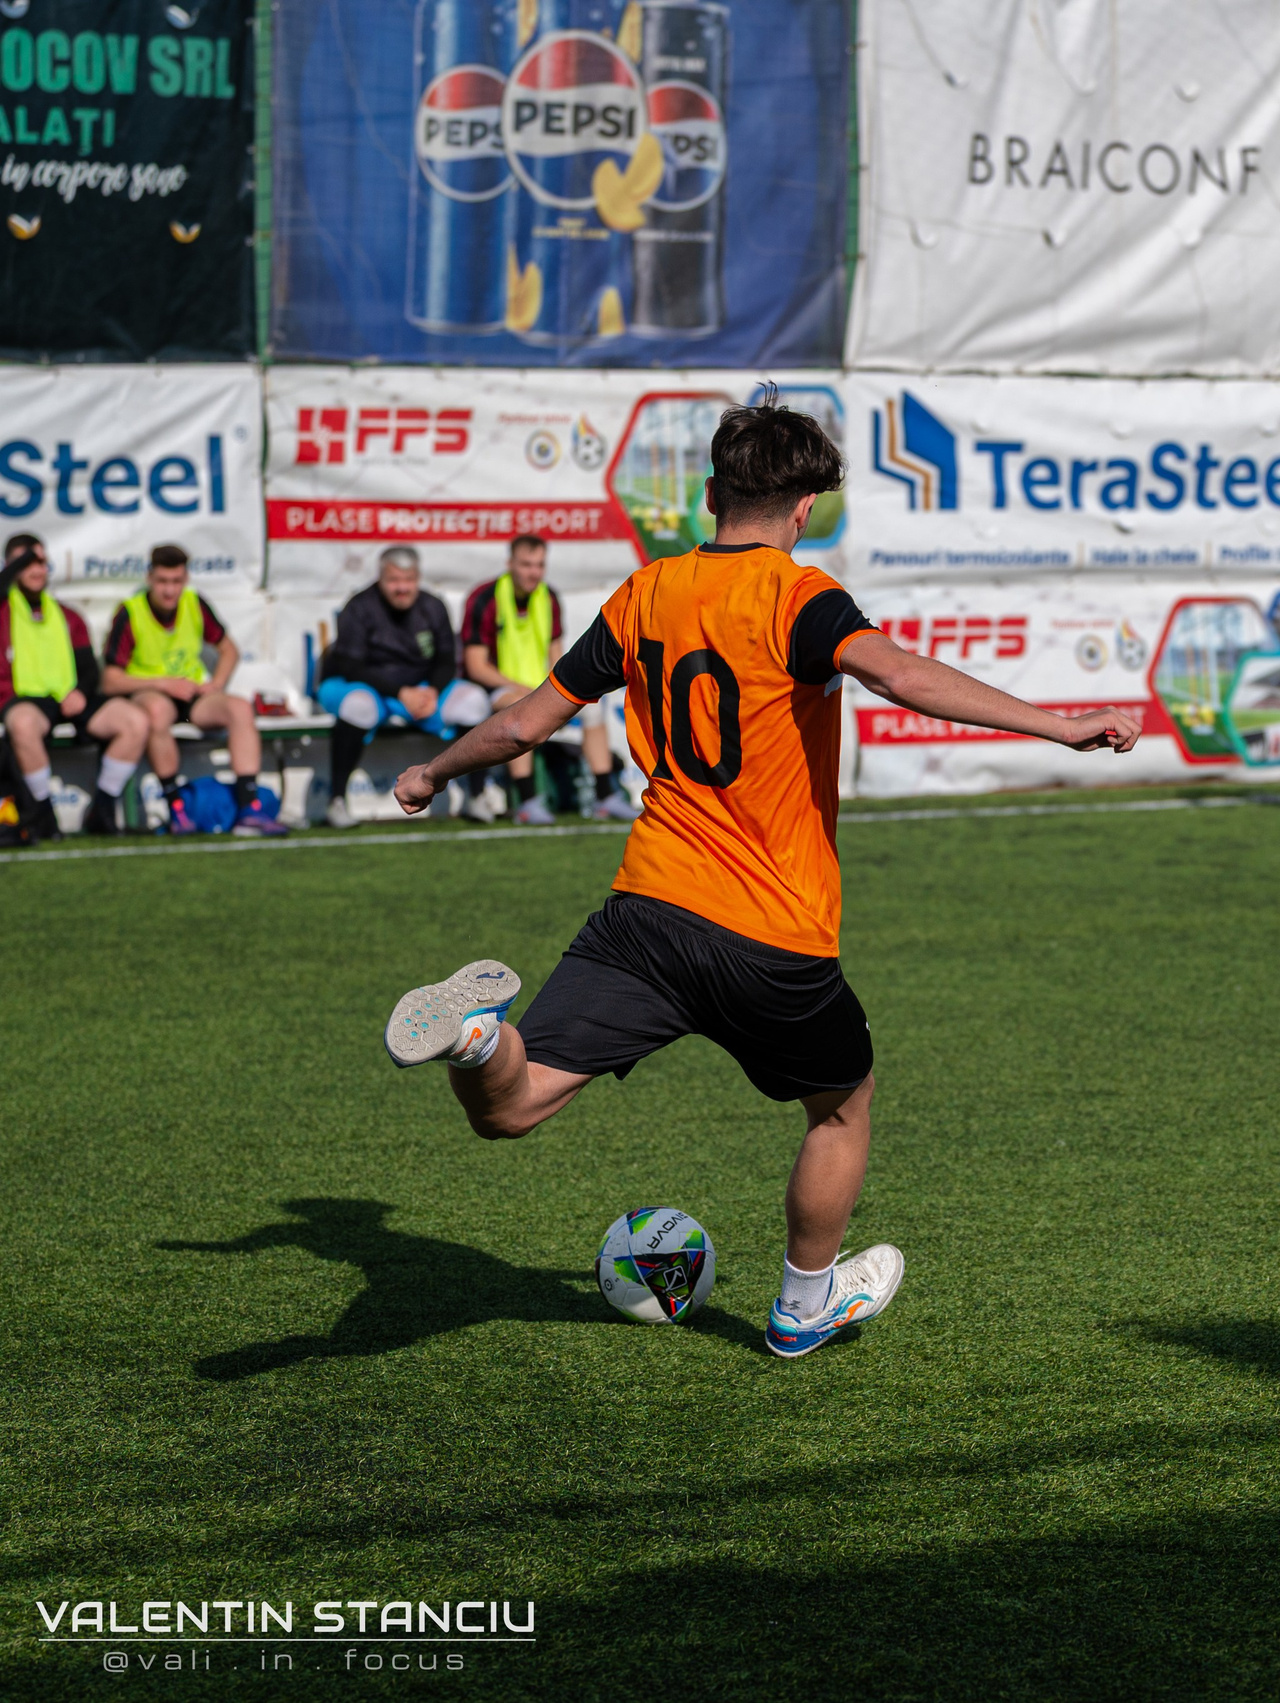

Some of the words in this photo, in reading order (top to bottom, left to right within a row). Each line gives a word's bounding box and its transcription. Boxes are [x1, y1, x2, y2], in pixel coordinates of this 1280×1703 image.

[148, 35, 235, 99] SRL
[513, 101, 635, 140] PEPSI
[967, 133, 1261, 196] BRAICONF
[356, 408, 473, 455] FPS
[0, 433, 225, 518] Steel
[286, 507, 376, 535] PLASE
[377, 507, 513, 538] PROTECȚIE
[515, 507, 602, 533] SPORT
[931, 617, 1028, 658] FPS
[636, 636, 742, 789] 10
[872, 712, 949, 737] PLASE
